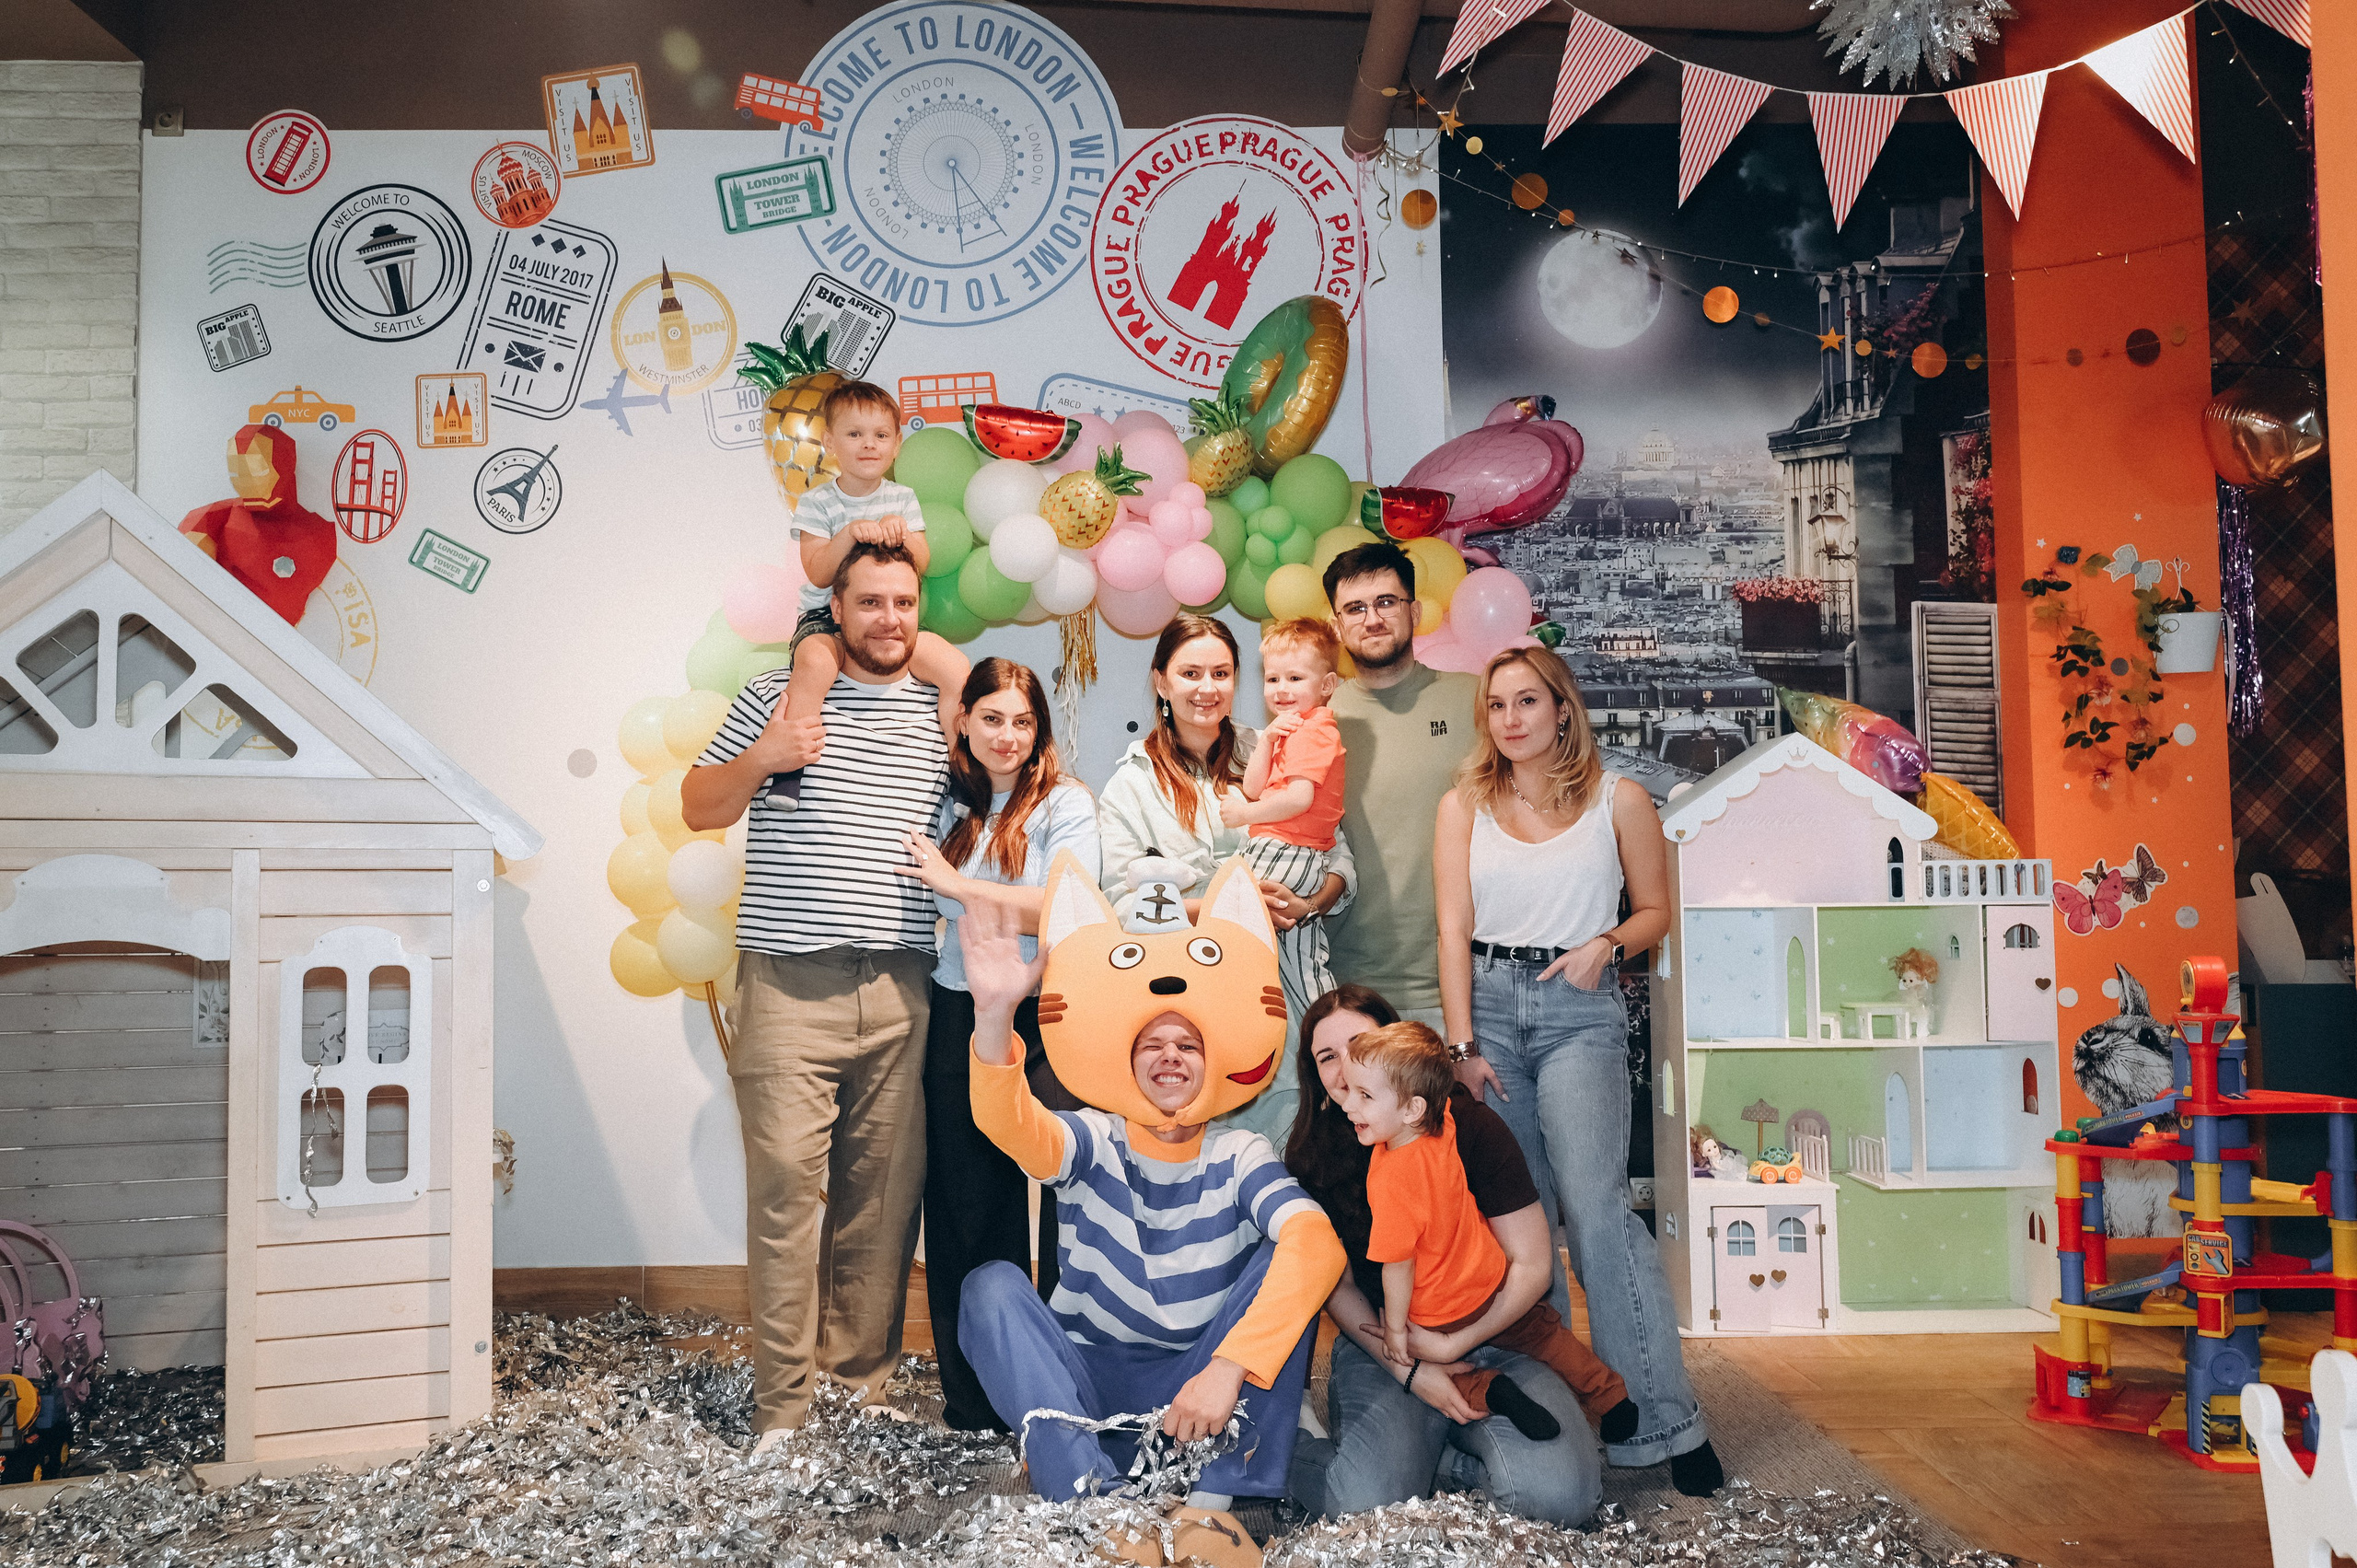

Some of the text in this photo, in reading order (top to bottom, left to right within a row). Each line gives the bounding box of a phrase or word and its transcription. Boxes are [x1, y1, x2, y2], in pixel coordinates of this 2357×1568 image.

[894, 16, 939, 55] TO
[954, 15, 1083, 105] LONDON
[892, 75, 955, 104] LONDON
[554, 88, 572, 162] VISIT US
[625, 77, 642, 152] VISIT US
[258, 127, 279, 159] LONDON
[1024, 122, 1044, 187] LONDON
[298, 147, 319, 180] LONDON
[521, 149, 553, 180] MOSCOW
[1217, 129, 1336, 203] PRAGUE
[479, 175, 493, 209] VISIT US
[746, 171, 800, 191] LONDON
[1111, 133, 1216, 226] PRAGUE
[331, 193, 411, 230] WELCOME TO
[753, 193, 801, 211] TOWER
[762, 205, 797, 219] BRIDGE
[863, 186, 910, 239] LONDON
[820, 133, 1106, 314] WELCOME TO LONDON
[508, 254, 595, 290] 04 JULY 2017
[1325, 212, 1356, 301] PRAG
[505, 290, 572, 331] ROME
[815, 285, 882, 319] BIG APPLE
[1104, 234, 1169, 356] PRAGUE
[204, 309, 250, 336] BIG APPLE
[373, 314, 426, 333] SEATTLE
[638, 363, 710, 385] WESTMINSTER
[288, 408, 310, 418] NYC
[1057, 397, 1082, 410] ABCD
[425, 424, 431, 437] US
[474, 422, 480, 436] US
[487, 496, 517, 524] PARIS
[433, 556, 461, 575] TOWER
[436, 541, 470, 563] LONDON
[433, 564, 456, 579] BRIDGE
[2188, 1234, 2201, 1243] CAR
[2200, 1237, 2228, 1249] SERVICE
